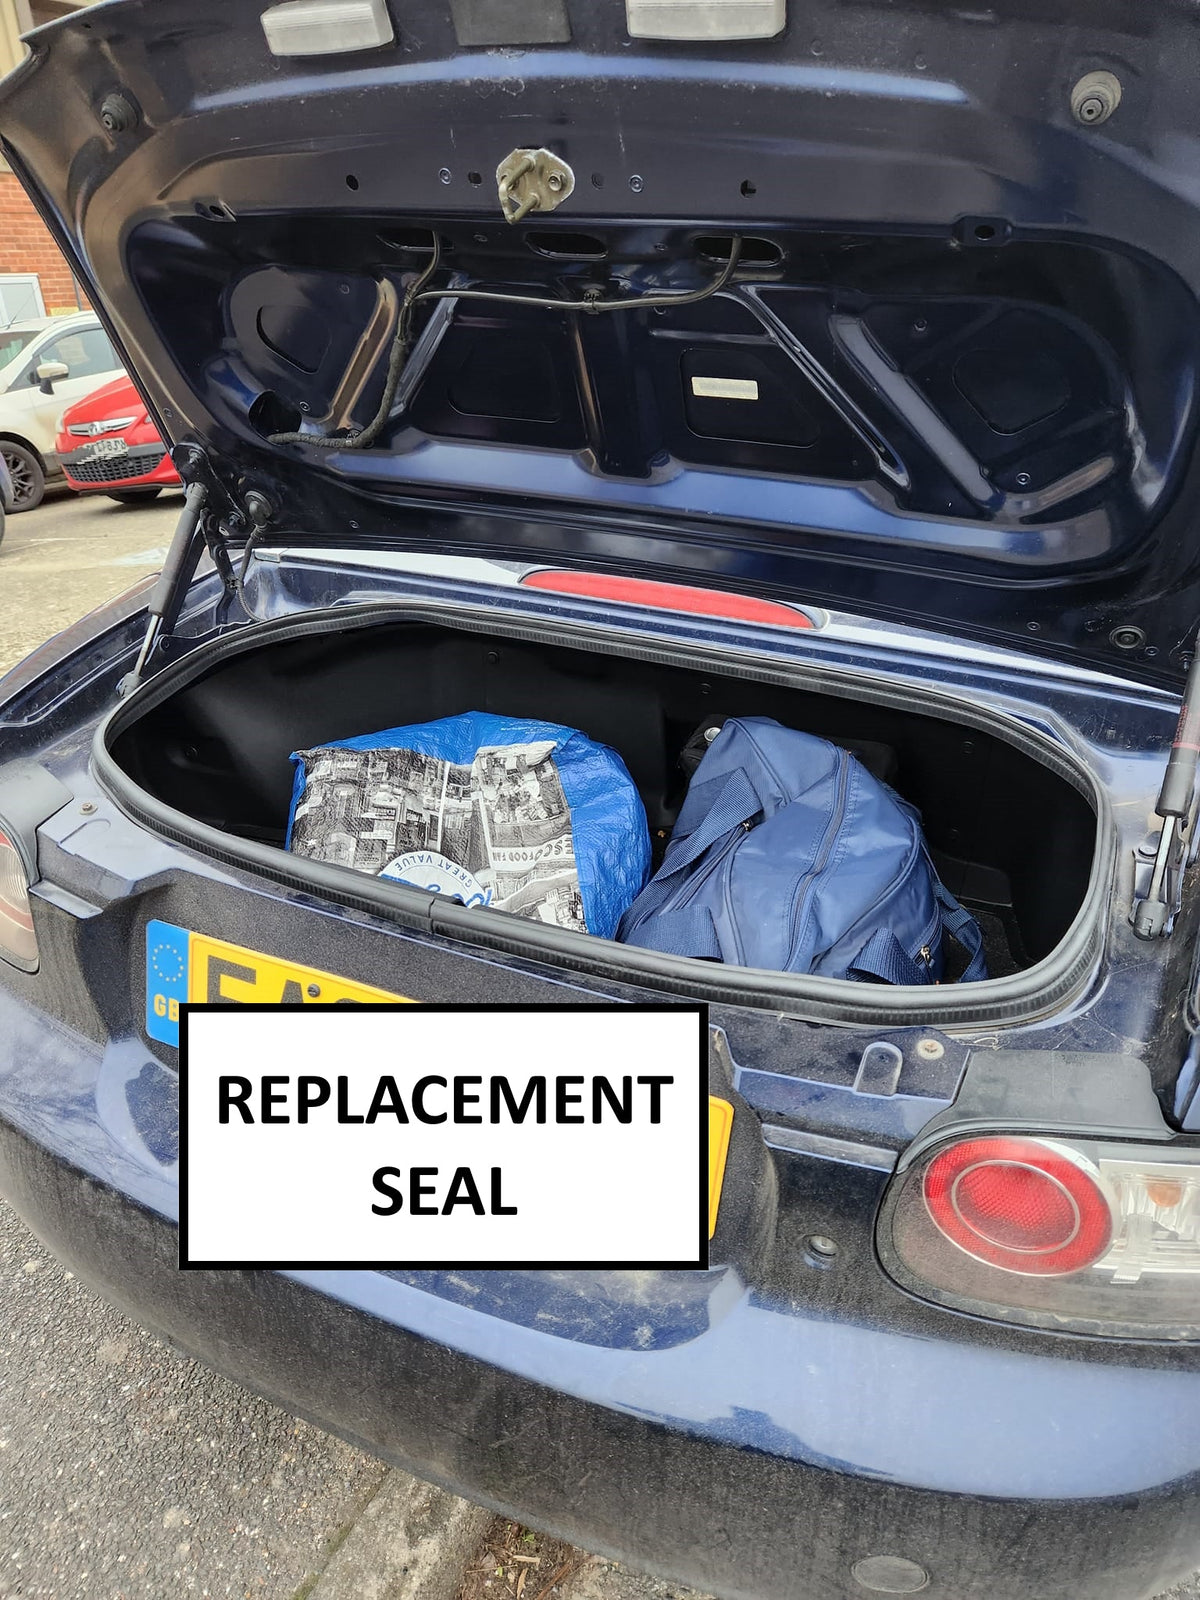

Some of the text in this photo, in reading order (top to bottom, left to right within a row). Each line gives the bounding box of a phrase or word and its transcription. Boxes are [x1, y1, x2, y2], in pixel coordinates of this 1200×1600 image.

[394, 854, 432, 871] VALUE
[508, 851, 534, 862] FOOD
[437, 859, 473, 887] GREAT
[154, 994, 179, 1022] GB
